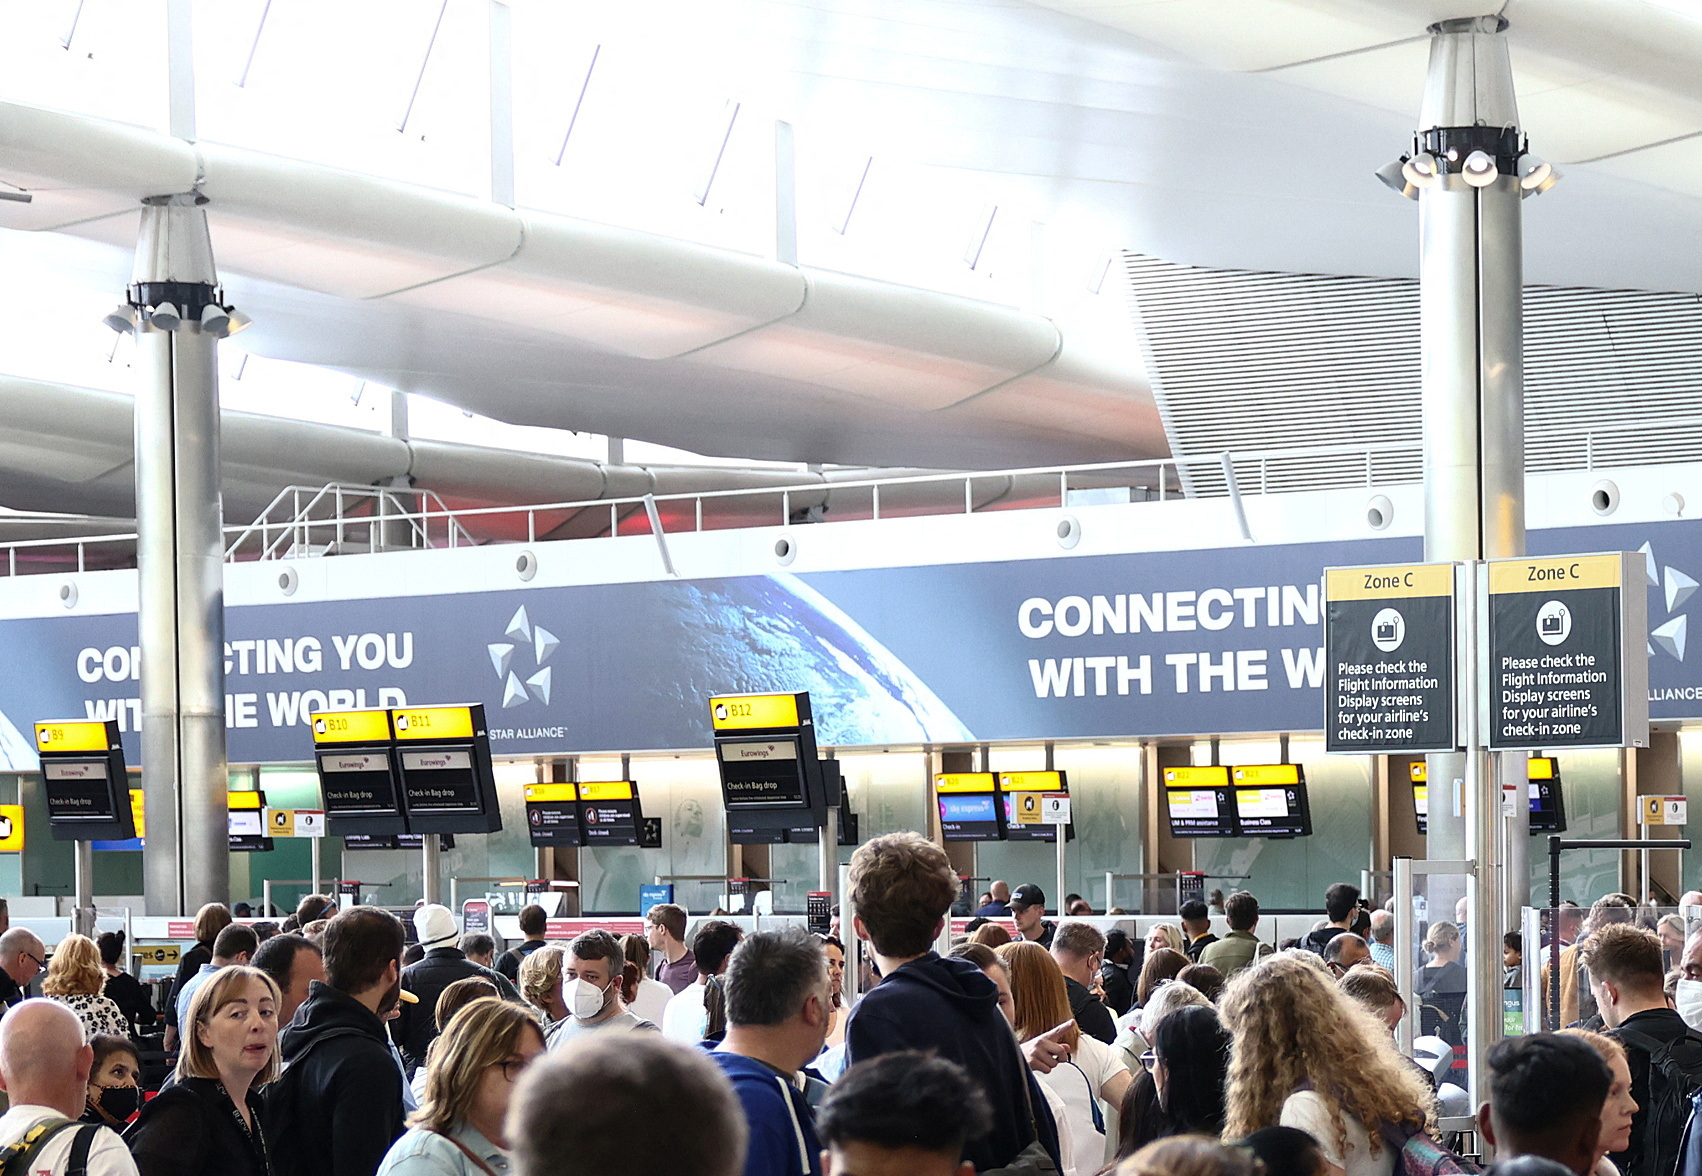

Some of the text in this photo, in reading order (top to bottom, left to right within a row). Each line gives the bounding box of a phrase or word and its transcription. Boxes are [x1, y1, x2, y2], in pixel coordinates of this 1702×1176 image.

[1528, 563, 1580, 581] Zone C
[1364, 573, 1413, 589] Zone C
[1018, 583, 1326, 639] CONNECTIN
[332, 632, 413, 670] YOU
[1338, 660, 1428, 675] Please check the
[1502, 654, 1595, 670] Please check the
[1028, 655, 1152, 698] WITH
[1165, 650, 1268, 693] THE
[1502, 670, 1607, 688] Flight Information
[1338, 676, 1438, 693] Flight Information
[1338, 694, 1423, 711] Display screens
[1502, 688, 1591, 705] Display screens
[731, 704, 752, 717] B12
[1338, 709, 1429, 726] for your airline's
[1502, 703, 1597, 722] for your airline's
[328, 719, 348, 730] B10
[411, 715, 431, 727] B11
[51, 729, 64, 740] B9
[489, 727, 564, 740] STAR ALLIANCE
[1338, 726, 1413, 740] check-in zone
[1502, 722, 1581, 737] check-in zone
[740, 750, 769, 758] Eurowings
[408, 788, 455, 798] Check-in Bag drop
[727, 781, 778, 791] Check-in Bag drop
[327, 790, 373, 800] Check-in Bag drop
